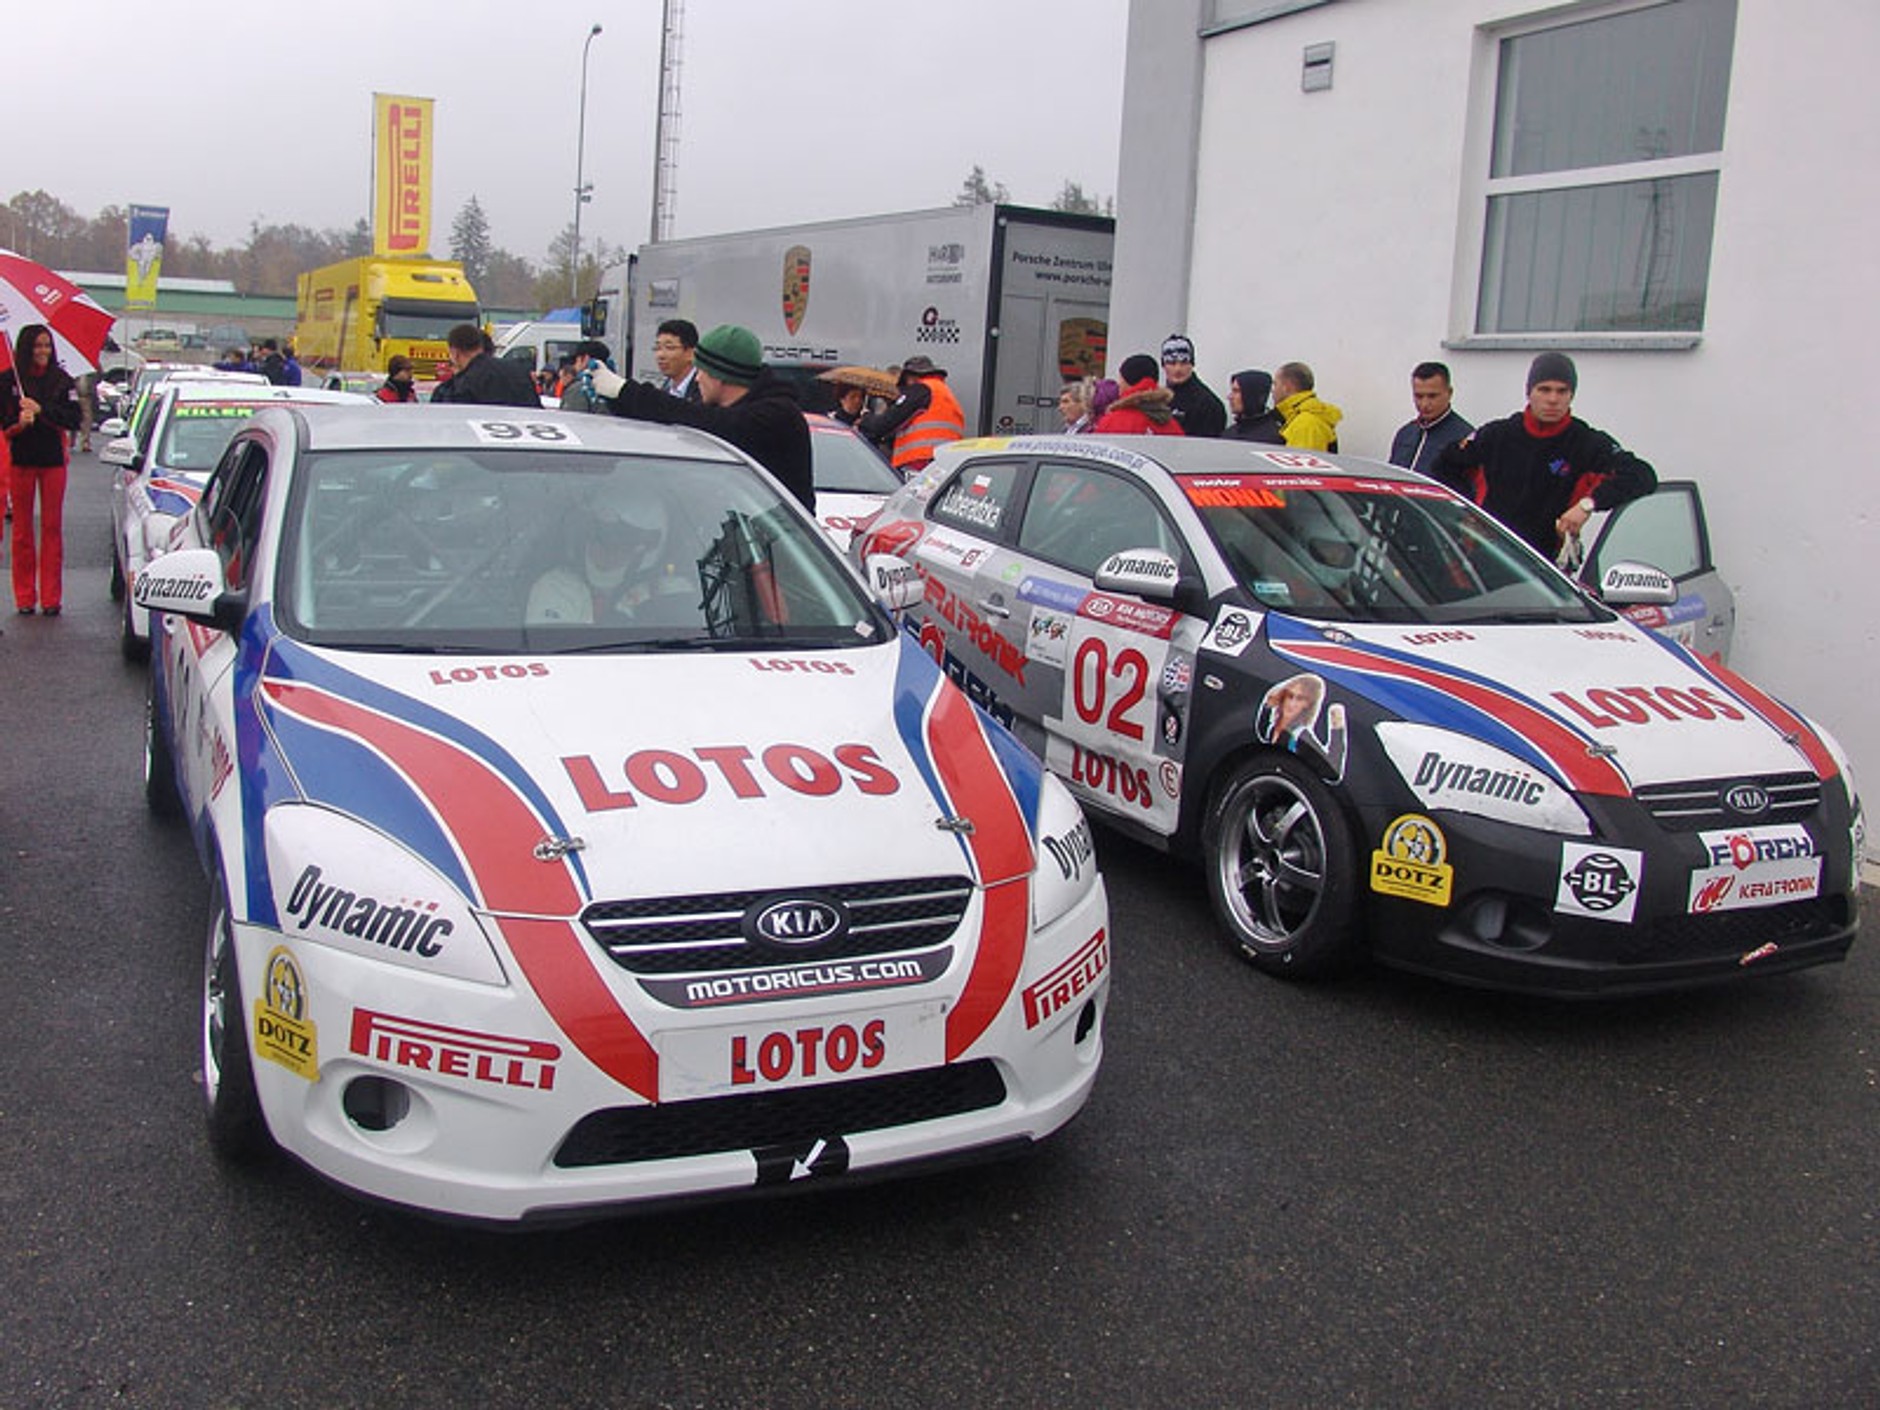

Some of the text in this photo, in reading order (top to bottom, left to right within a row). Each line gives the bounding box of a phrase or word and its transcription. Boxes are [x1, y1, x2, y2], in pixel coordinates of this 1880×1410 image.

[388, 104, 422, 250] PIRELLI
[1012, 250, 1052, 267] Porsche
[1053, 256, 1095, 271] Zentrum
[481, 422, 568, 441] 98
[1105, 556, 1176, 579] Dynamic
[1606, 568, 1670, 590] Dynamic
[133, 571, 213, 603] Dynamic
[1401, 629, 1476, 645] LOTOS
[429, 662, 551, 685] LOTOS
[748, 656, 856, 676] LOTOS
[1074, 636, 1150, 741] 02
[1550, 685, 1746, 729] LOTOS
[561, 743, 902, 813] LOTOS
[1071, 744, 1153, 809] LOTOS
[1414, 750, 1546, 808] Dynamic
[1733, 791, 1764, 808] KIA
[1710, 834, 1812, 870] FÖRCH
[1376, 862, 1445, 890] DOTZ
[1583, 870, 1619, 895] BL
[1738, 876, 1816, 900] KERATRONIK
[286, 864, 453, 959] Dynamic
[771, 907, 826, 936] KIA
[1022, 927, 1108, 1031] PIRELLI
[258, 1016, 312, 1057] DOTZ
[349, 1007, 563, 1091] PIRELLI
[730, 1018, 886, 1086] LOTOS
